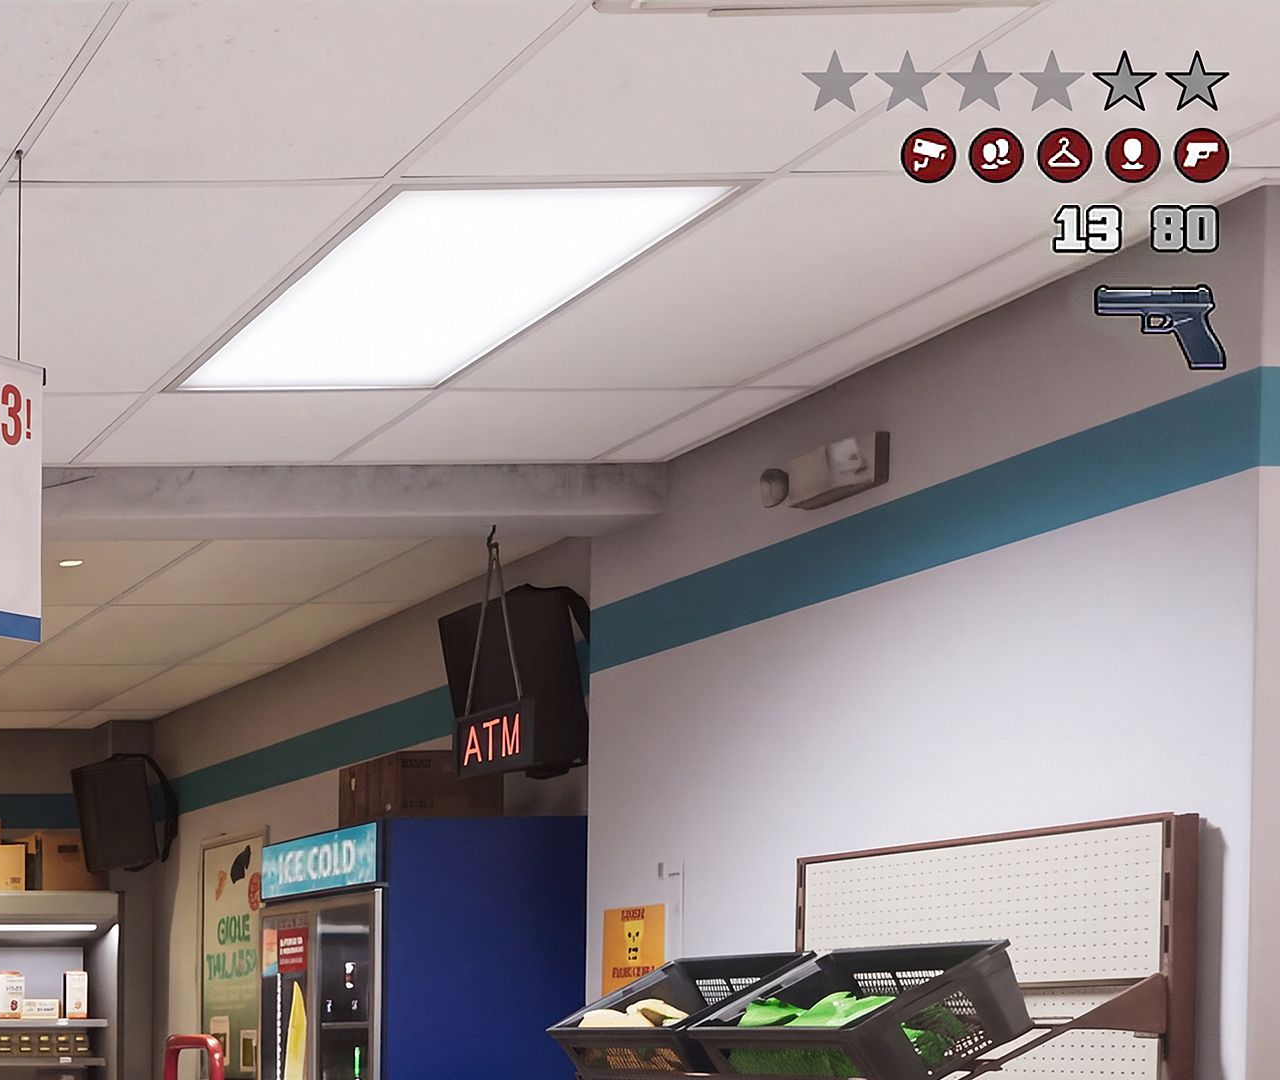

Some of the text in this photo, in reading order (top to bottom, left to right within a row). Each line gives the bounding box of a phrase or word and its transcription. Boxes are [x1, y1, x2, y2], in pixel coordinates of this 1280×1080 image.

[463, 712, 520, 766] ATM
[278, 839, 357, 884] ICE COLD
